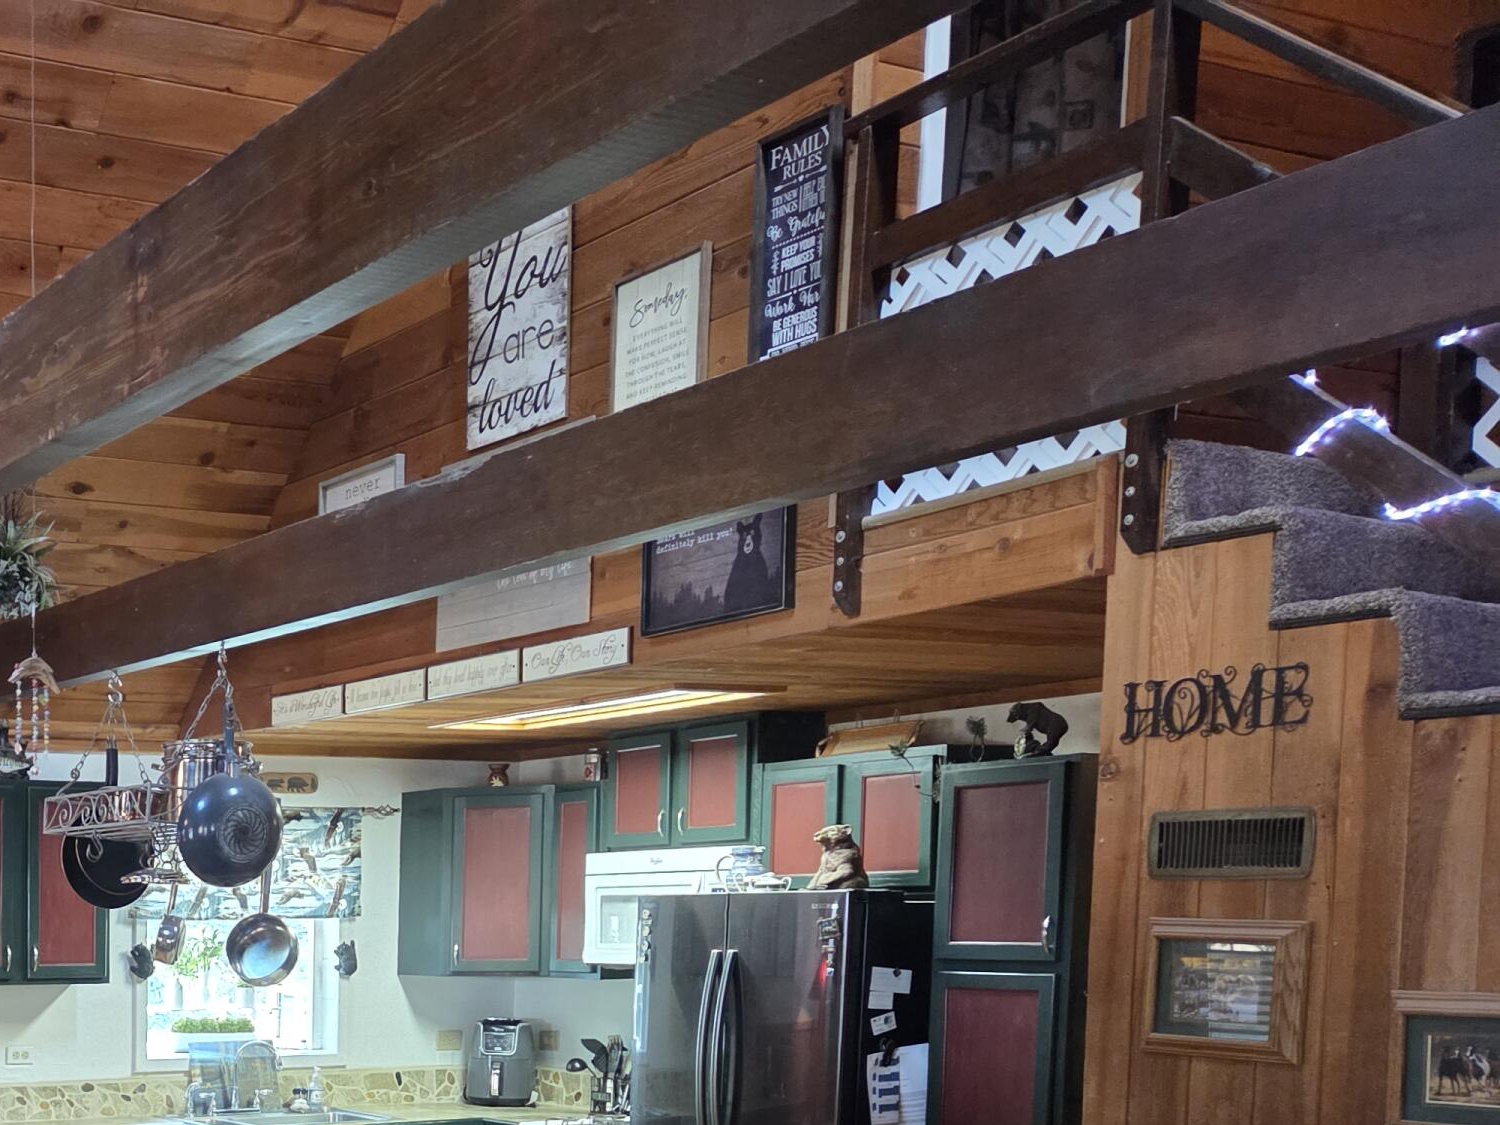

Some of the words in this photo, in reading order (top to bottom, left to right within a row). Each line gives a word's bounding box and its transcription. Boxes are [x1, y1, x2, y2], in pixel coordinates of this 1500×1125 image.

[770, 124, 830, 170] FAMILY
[782, 151, 822, 180] RULES
[783, 187, 798, 202] NEW
[771, 199, 798, 220] THINGS
[787, 206, 826, 237] Gratefu
[780, 248, 815, 272] PROMISES
[781, 242, 799, 259] KEEP
[799, 235, 816, 252] YOUR
[766, 275, 783, 297] SAY
[790, 265, 807, 289] LOVE
[469, 231, 568, 385] You
[772, 318, 782, 333] BE
[782, 306, 818, 329] GENEROUS
[503, 319, 554, 364] are
[772, 325, 793, 347] WITH
[794, 317, 817, 339] HUGS
[479, 359, 557, 433] loved
[345, 477, 380, 500] never
[656, 538, 695, 554] definitely
[697, 532, 713, 544] kill
[1120, 661, 1313, 745] HOME
